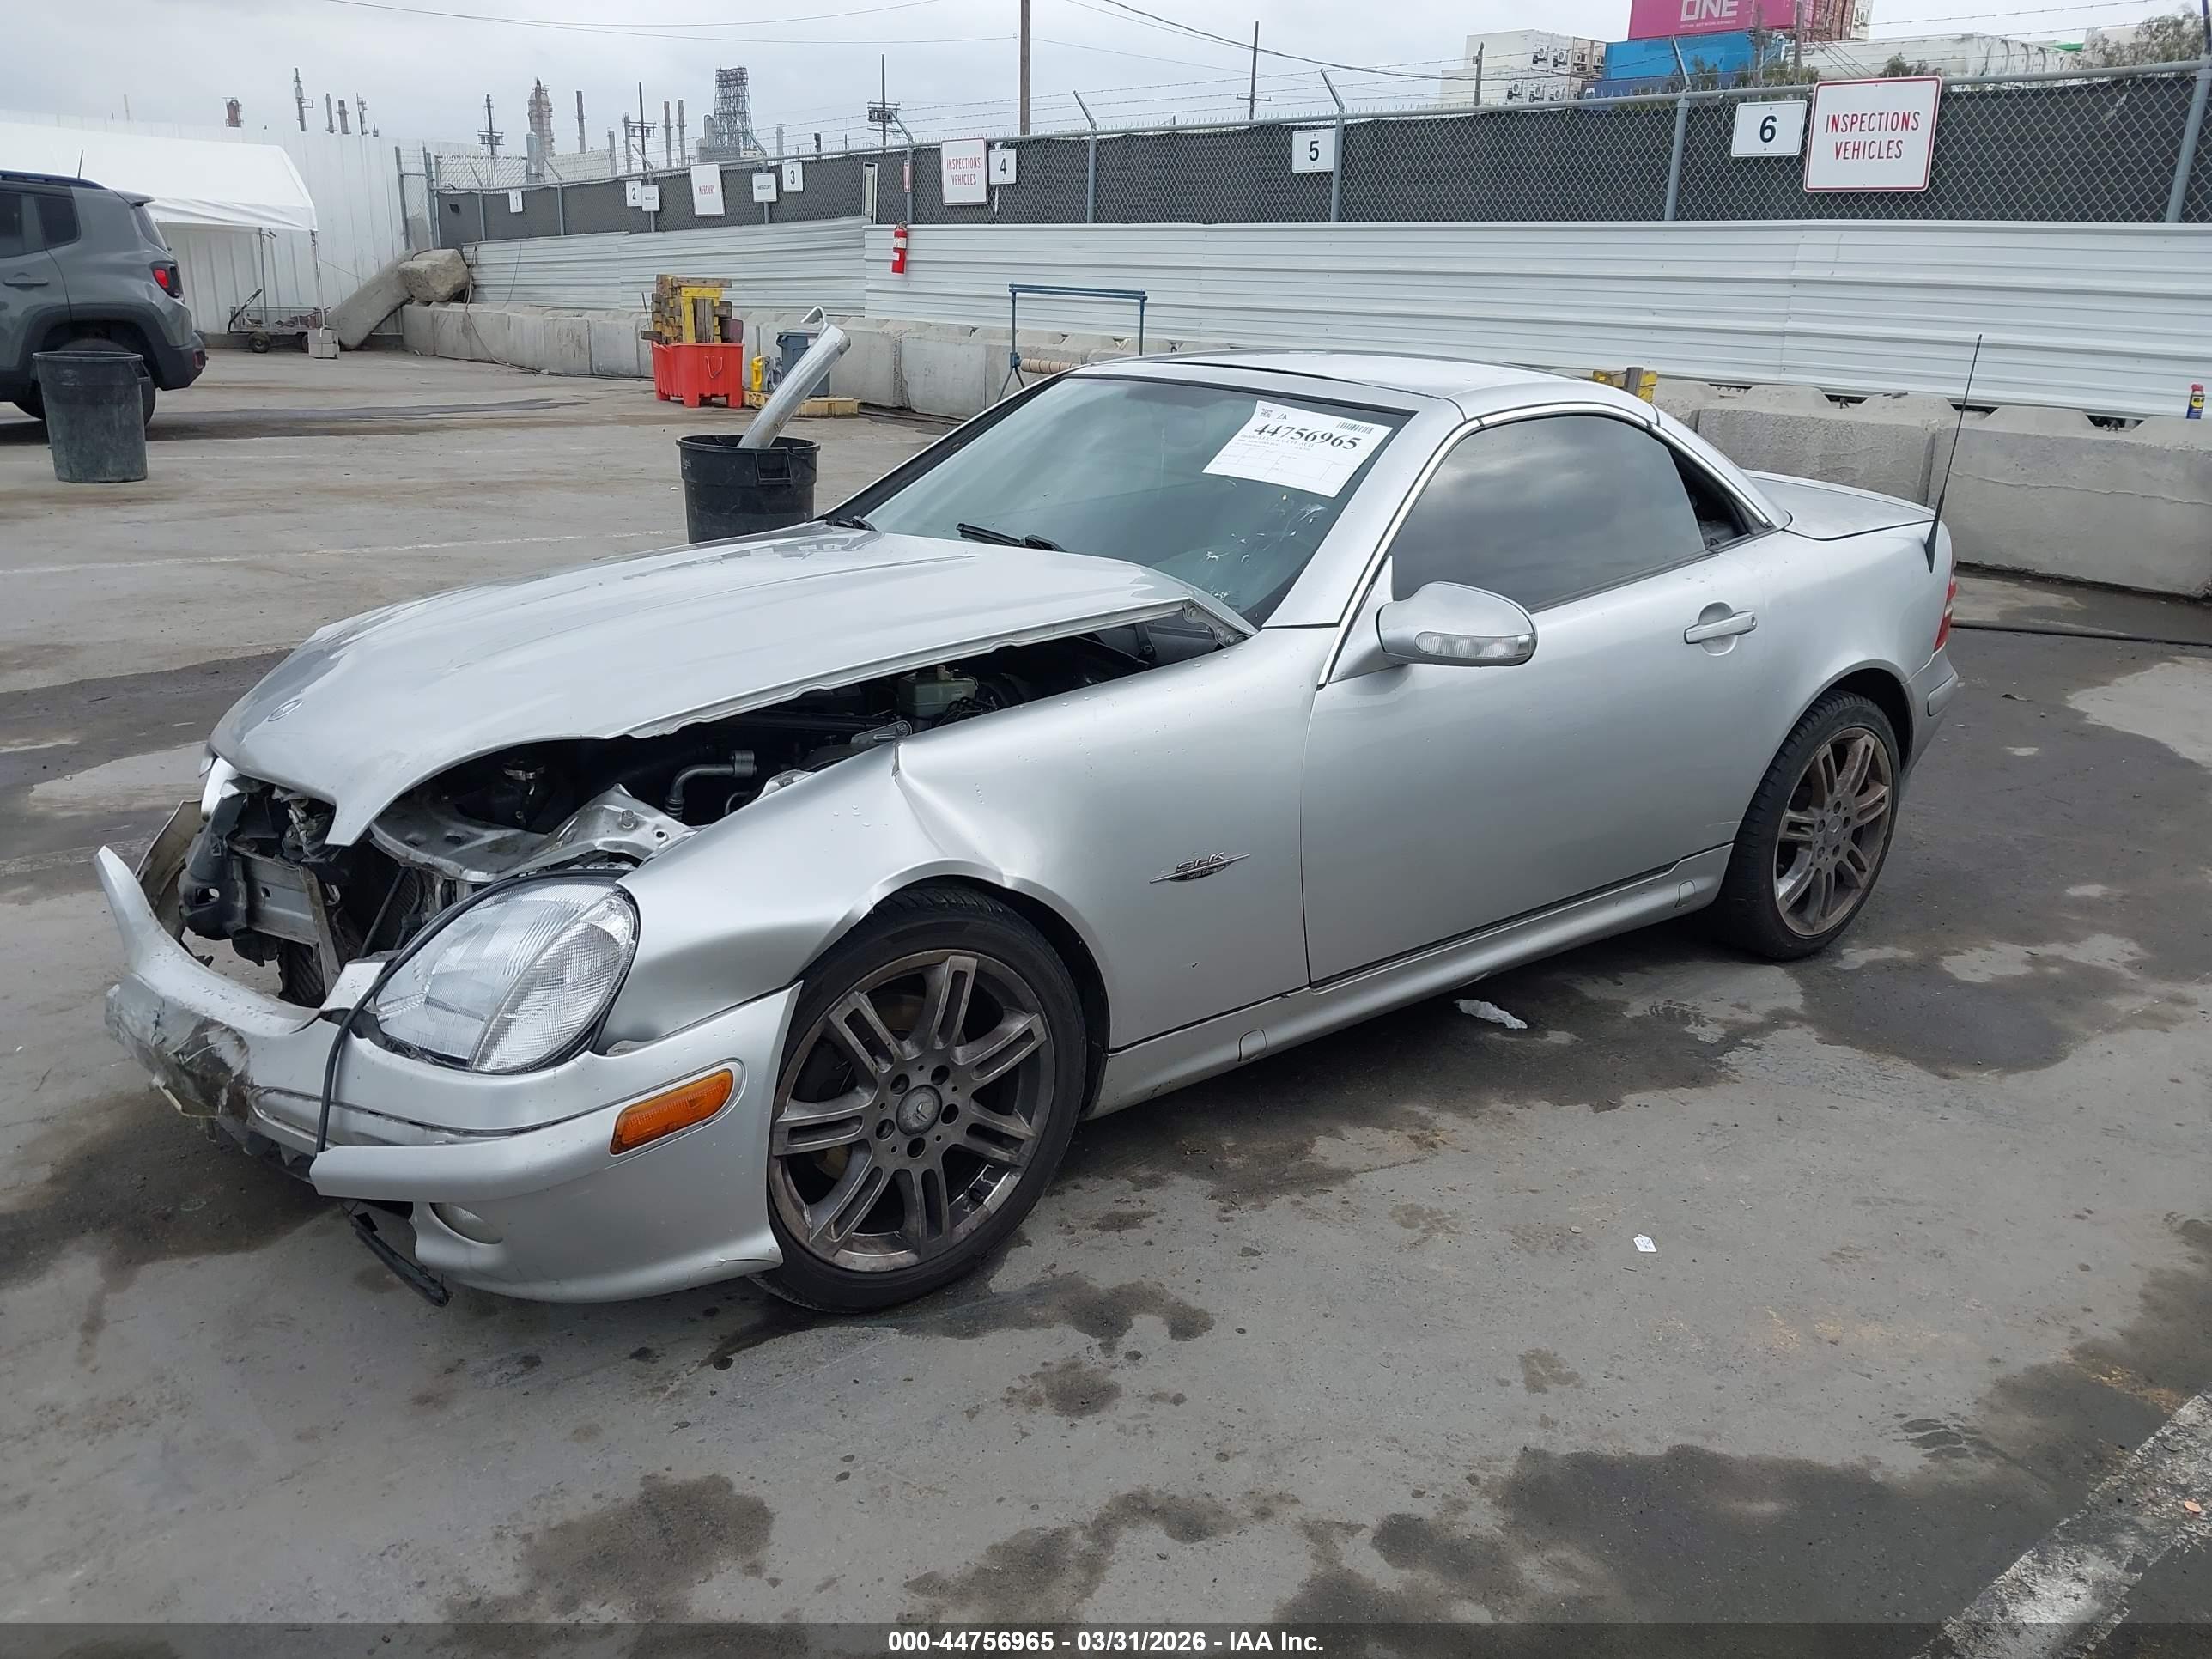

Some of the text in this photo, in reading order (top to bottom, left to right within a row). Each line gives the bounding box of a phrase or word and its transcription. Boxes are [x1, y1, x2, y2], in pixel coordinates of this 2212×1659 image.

[1680, 0, 1738, 21] ONE
[1759, 115, 1778, 143] 6
[1825, 111, 1921, 134] INSPECTIONS
[1309, 140, 1320, 161] 5
[1834, 139, 1905, 161] VEHICLES
[946, 156, 981, 170] INSPECTIONS
[1000, 157, 1007, 176] 4
[790, 170, 796, 185] 3
[951, 173, 977, 186] VEHICLES
[631, 187, 637, 200] 2
[1254, 423, 1363, 449] 44756965
[1176, 851, 1225, 872] SLK
